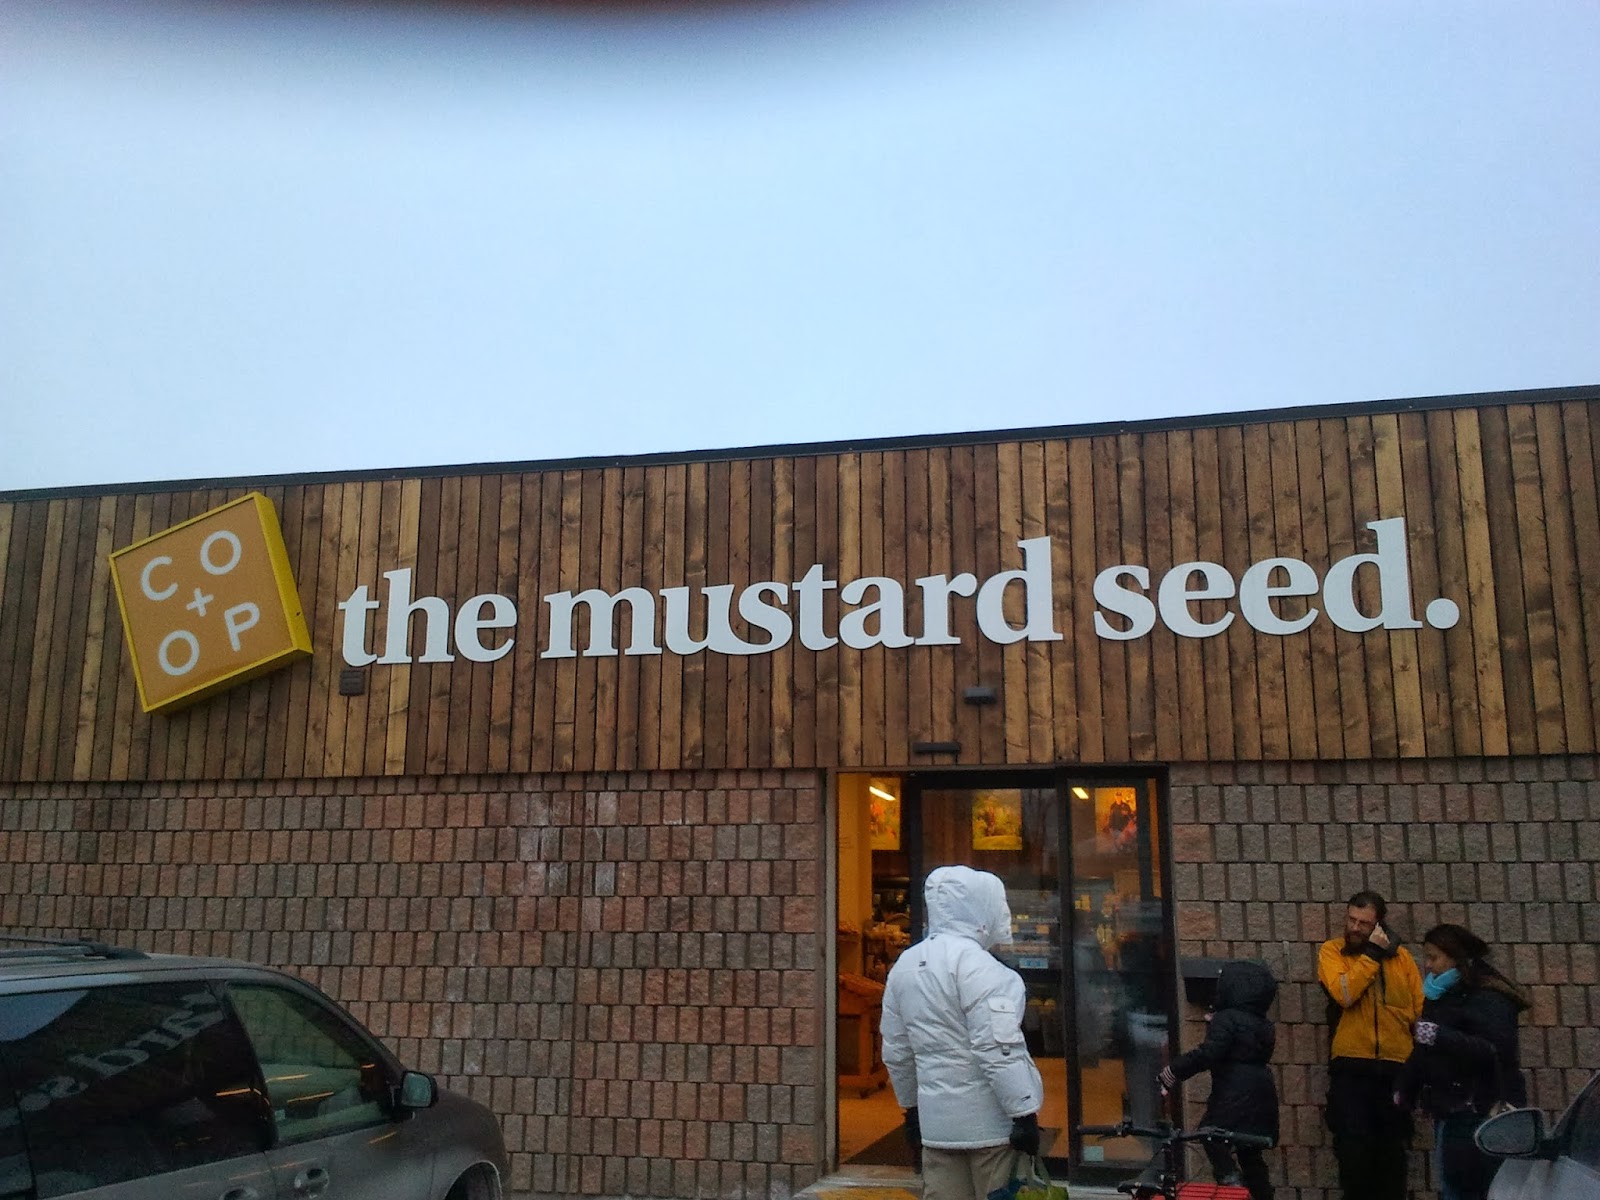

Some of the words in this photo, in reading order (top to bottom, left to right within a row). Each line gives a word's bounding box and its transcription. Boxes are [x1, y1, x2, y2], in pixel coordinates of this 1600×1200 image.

[338, 567, 518, 667] the
[540, 535, 1064, 660] mustard
[1092, 516, 1461, 642] seed.
